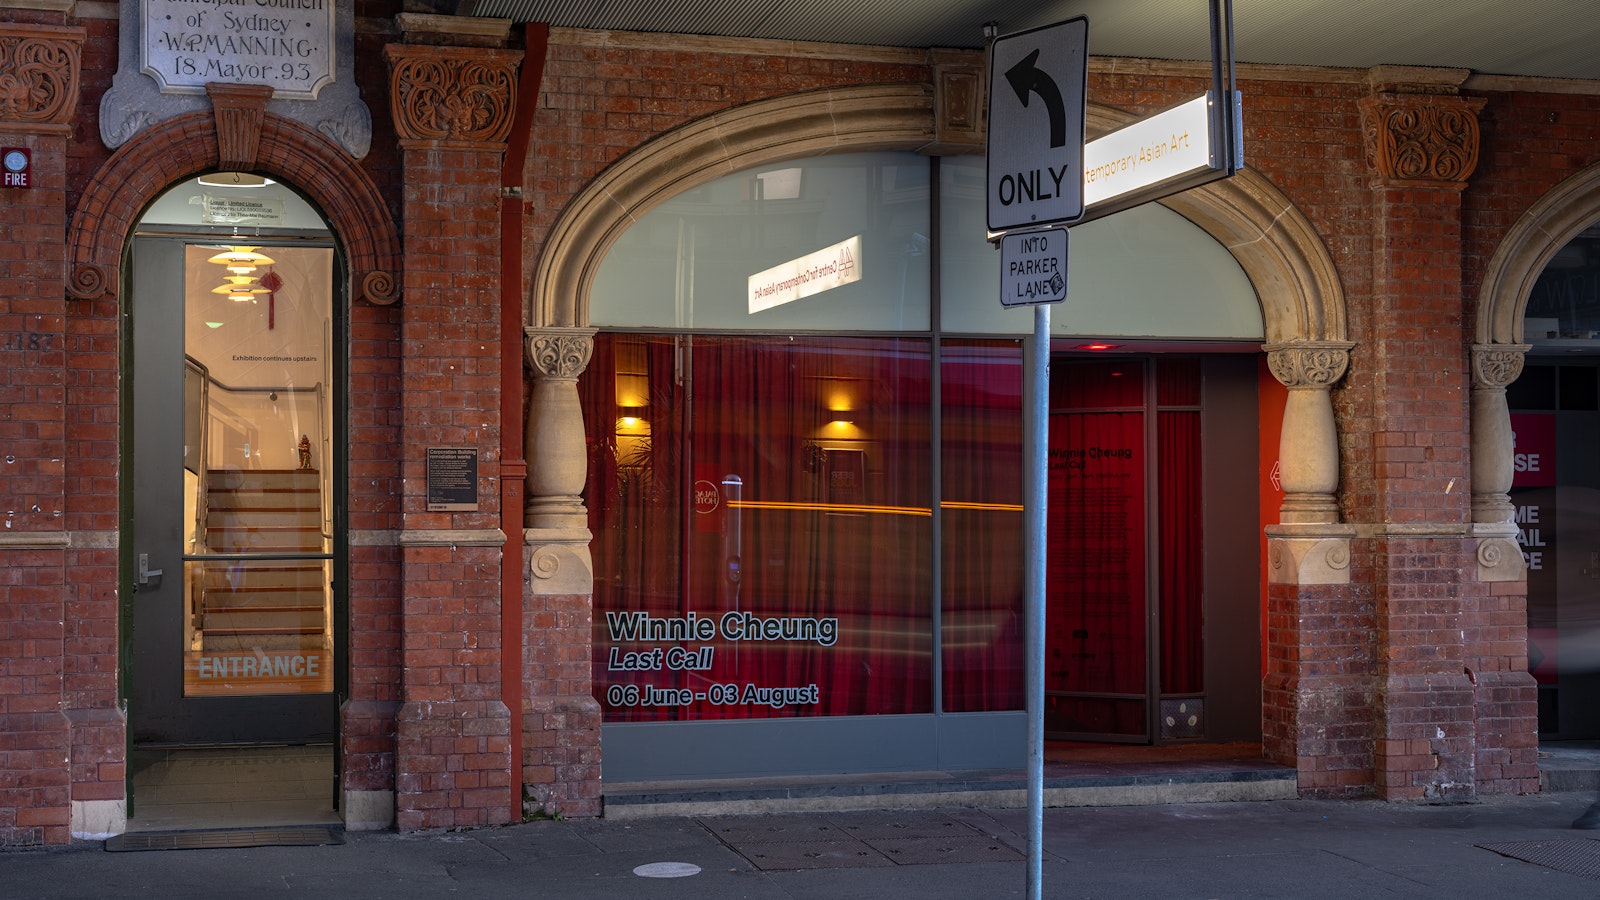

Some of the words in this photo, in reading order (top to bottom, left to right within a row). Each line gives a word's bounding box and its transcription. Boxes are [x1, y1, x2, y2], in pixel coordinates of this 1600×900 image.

[186, 10, 207, 28] of
[223, 11, 291, 35] Sydney
[1138, 141, 1168, 165] Asian
[1170, 128, 1190, 153] Art
[4, 172, 27, 186] FIRE
[998, 164, 1069, 206] ONLY
[1020, 236, 1048, 254] INTO
[1010, 257, 1059, 277] PARKER
[1017, 280, 1050, 297] LANE
[1048, 447, 1087, 459] Winnie
[1088, 447, 1132, 459] Cheung
[606, 611, 716, 641] Winnie
[720, 611, 838, 646] Cheung
[198, 655, 320, 678] ENTRANCE
[608, 647, 663, 671] Last
[666, 646, 714, 671] Call
[607, 685, 640, 707] 06
[641, 684, 692, 706] June
[708, 684, 738, 706] 03
[740, 683, 819, 708] August
